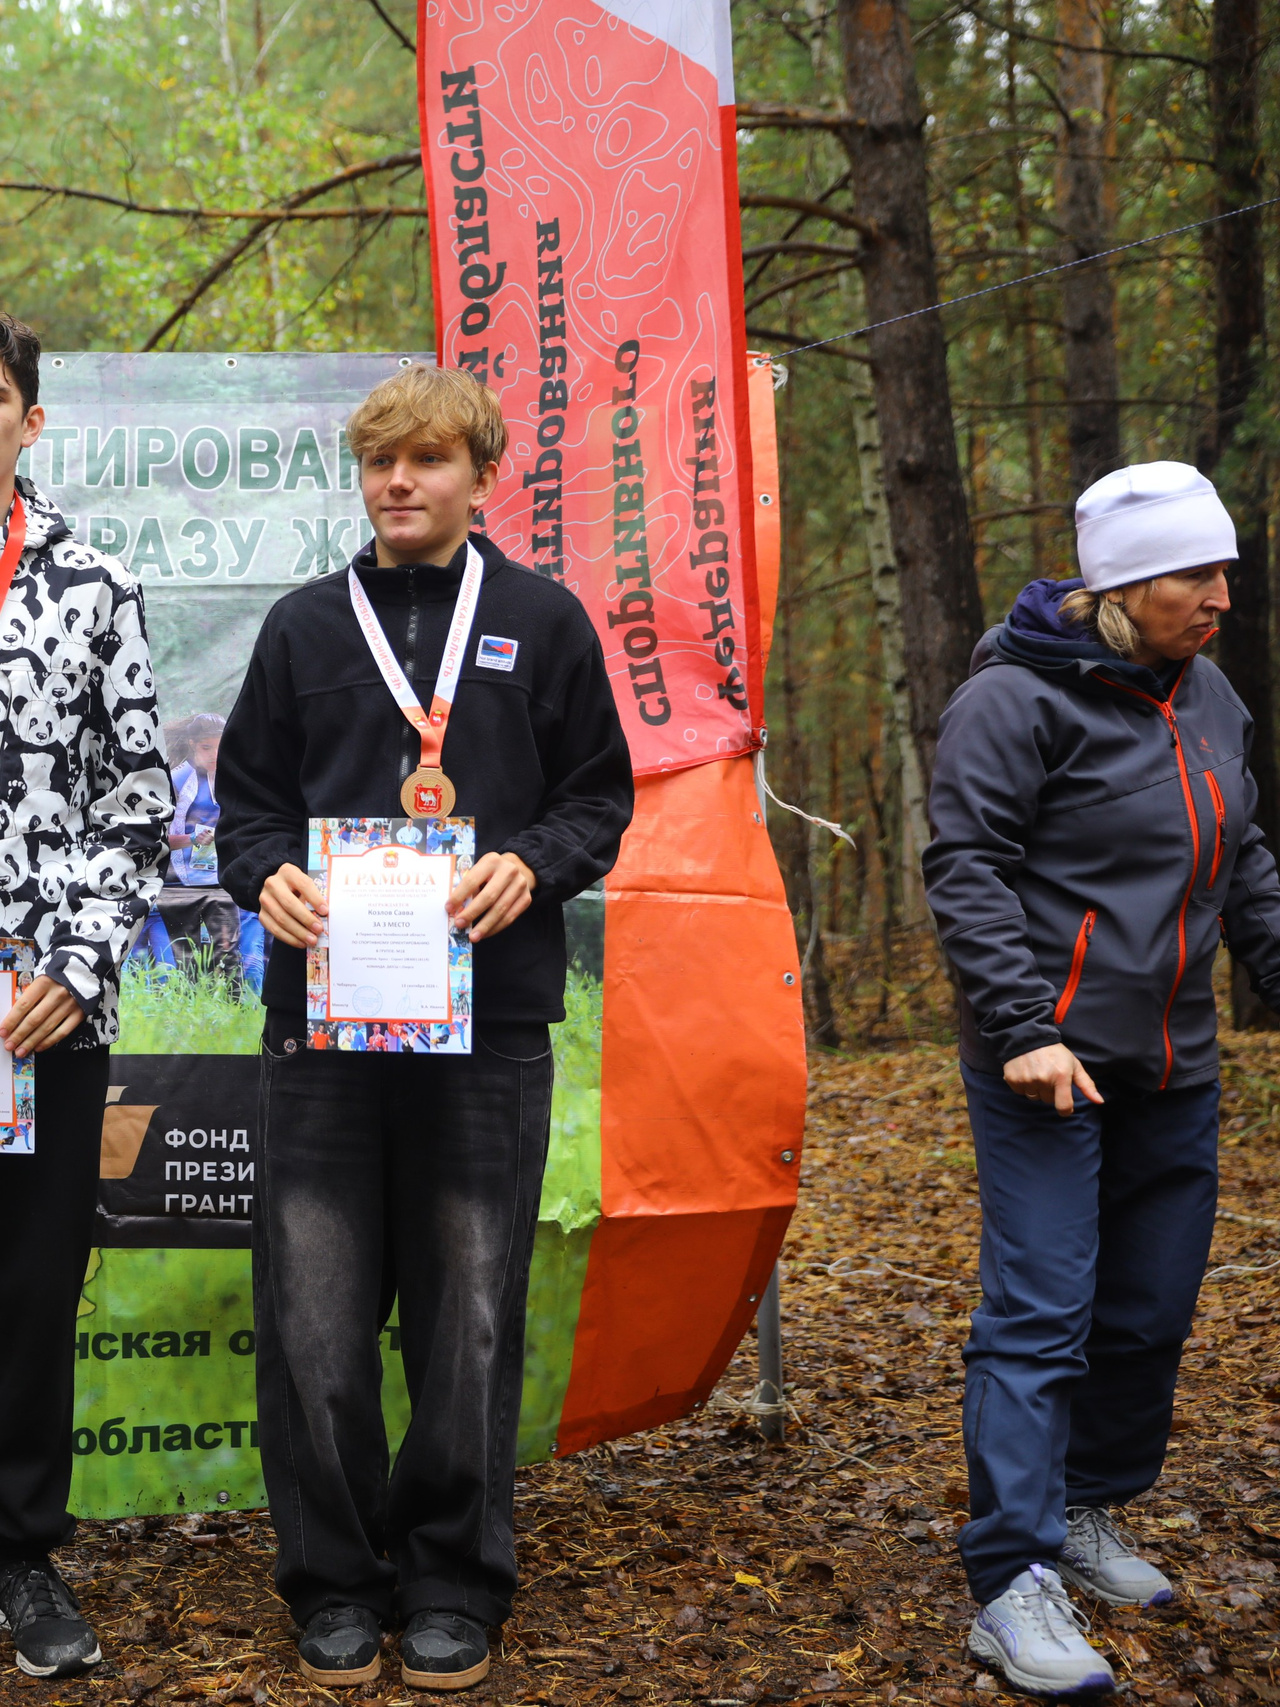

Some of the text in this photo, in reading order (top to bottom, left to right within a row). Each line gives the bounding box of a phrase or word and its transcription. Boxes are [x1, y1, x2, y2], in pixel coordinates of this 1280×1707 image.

[64, 515, 267, 579] РАЗУ
[352, 579, 402, 690] ЧЕЛЯБИНСКАЯ ОБЛАСТЬ
[444, 555, 478, 678] ЧЕЛЯБИНСКАЯ ОБЛАСТЬ
[344, 872, 436, 886] ГРАМОТА
[164, 1128, 250, 1153] ФОНД
